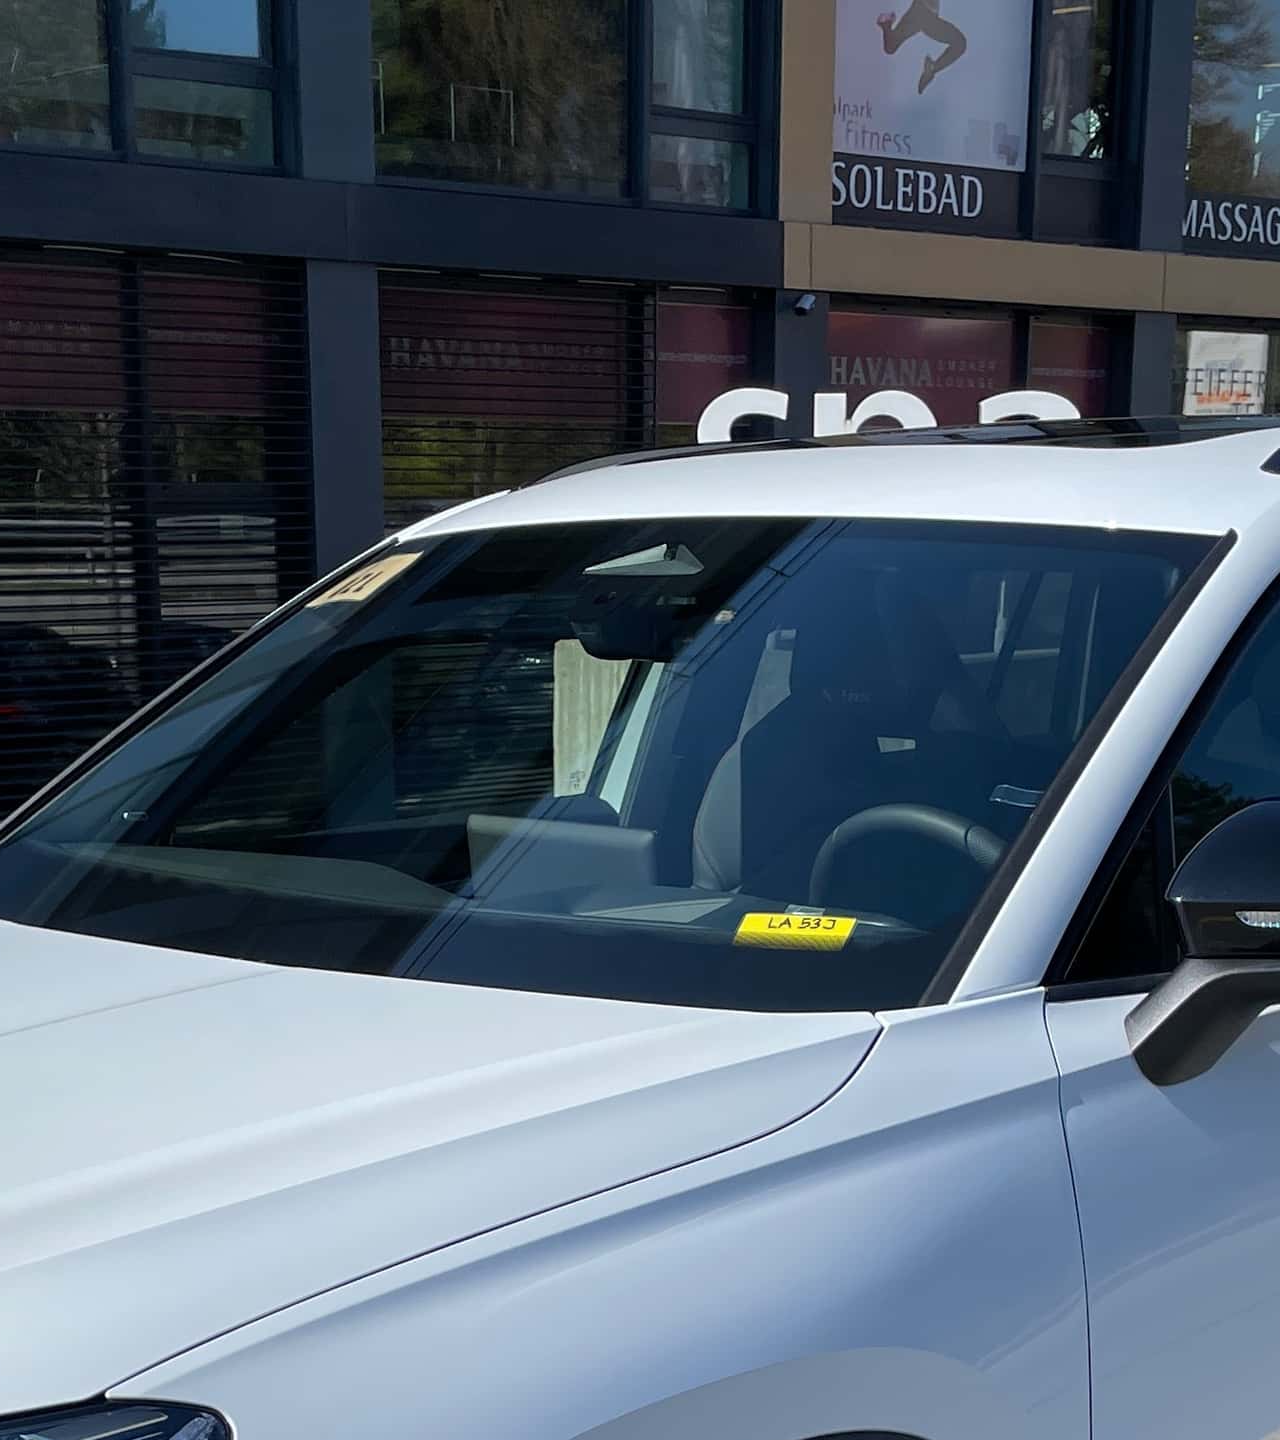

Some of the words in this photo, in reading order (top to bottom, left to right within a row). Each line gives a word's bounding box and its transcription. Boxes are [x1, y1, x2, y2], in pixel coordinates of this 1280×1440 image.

[832, 161, 983, 218] SOLEBAD
[830, 356, 932, 387] HAVANA
[768, 917, 792, 929] LA
